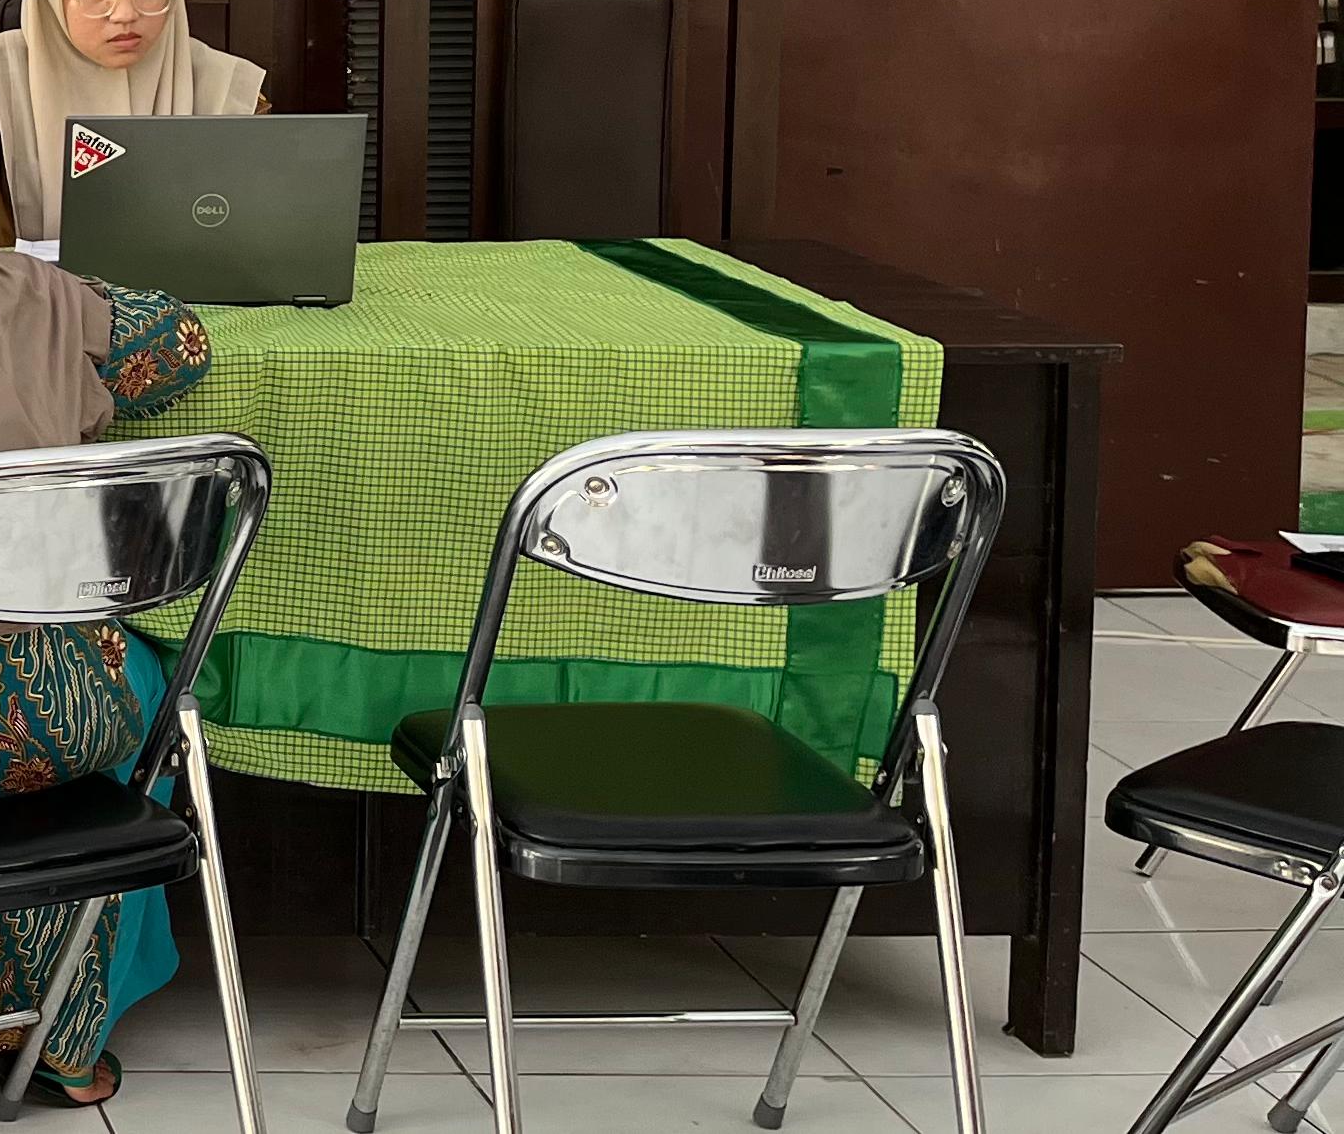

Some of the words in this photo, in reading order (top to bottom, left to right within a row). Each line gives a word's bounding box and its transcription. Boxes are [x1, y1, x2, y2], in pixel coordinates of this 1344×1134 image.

[75, 131, 118, 158] safety
[75, 147, 99, 168] 1st
[196, 205, 225, 215] DELL
